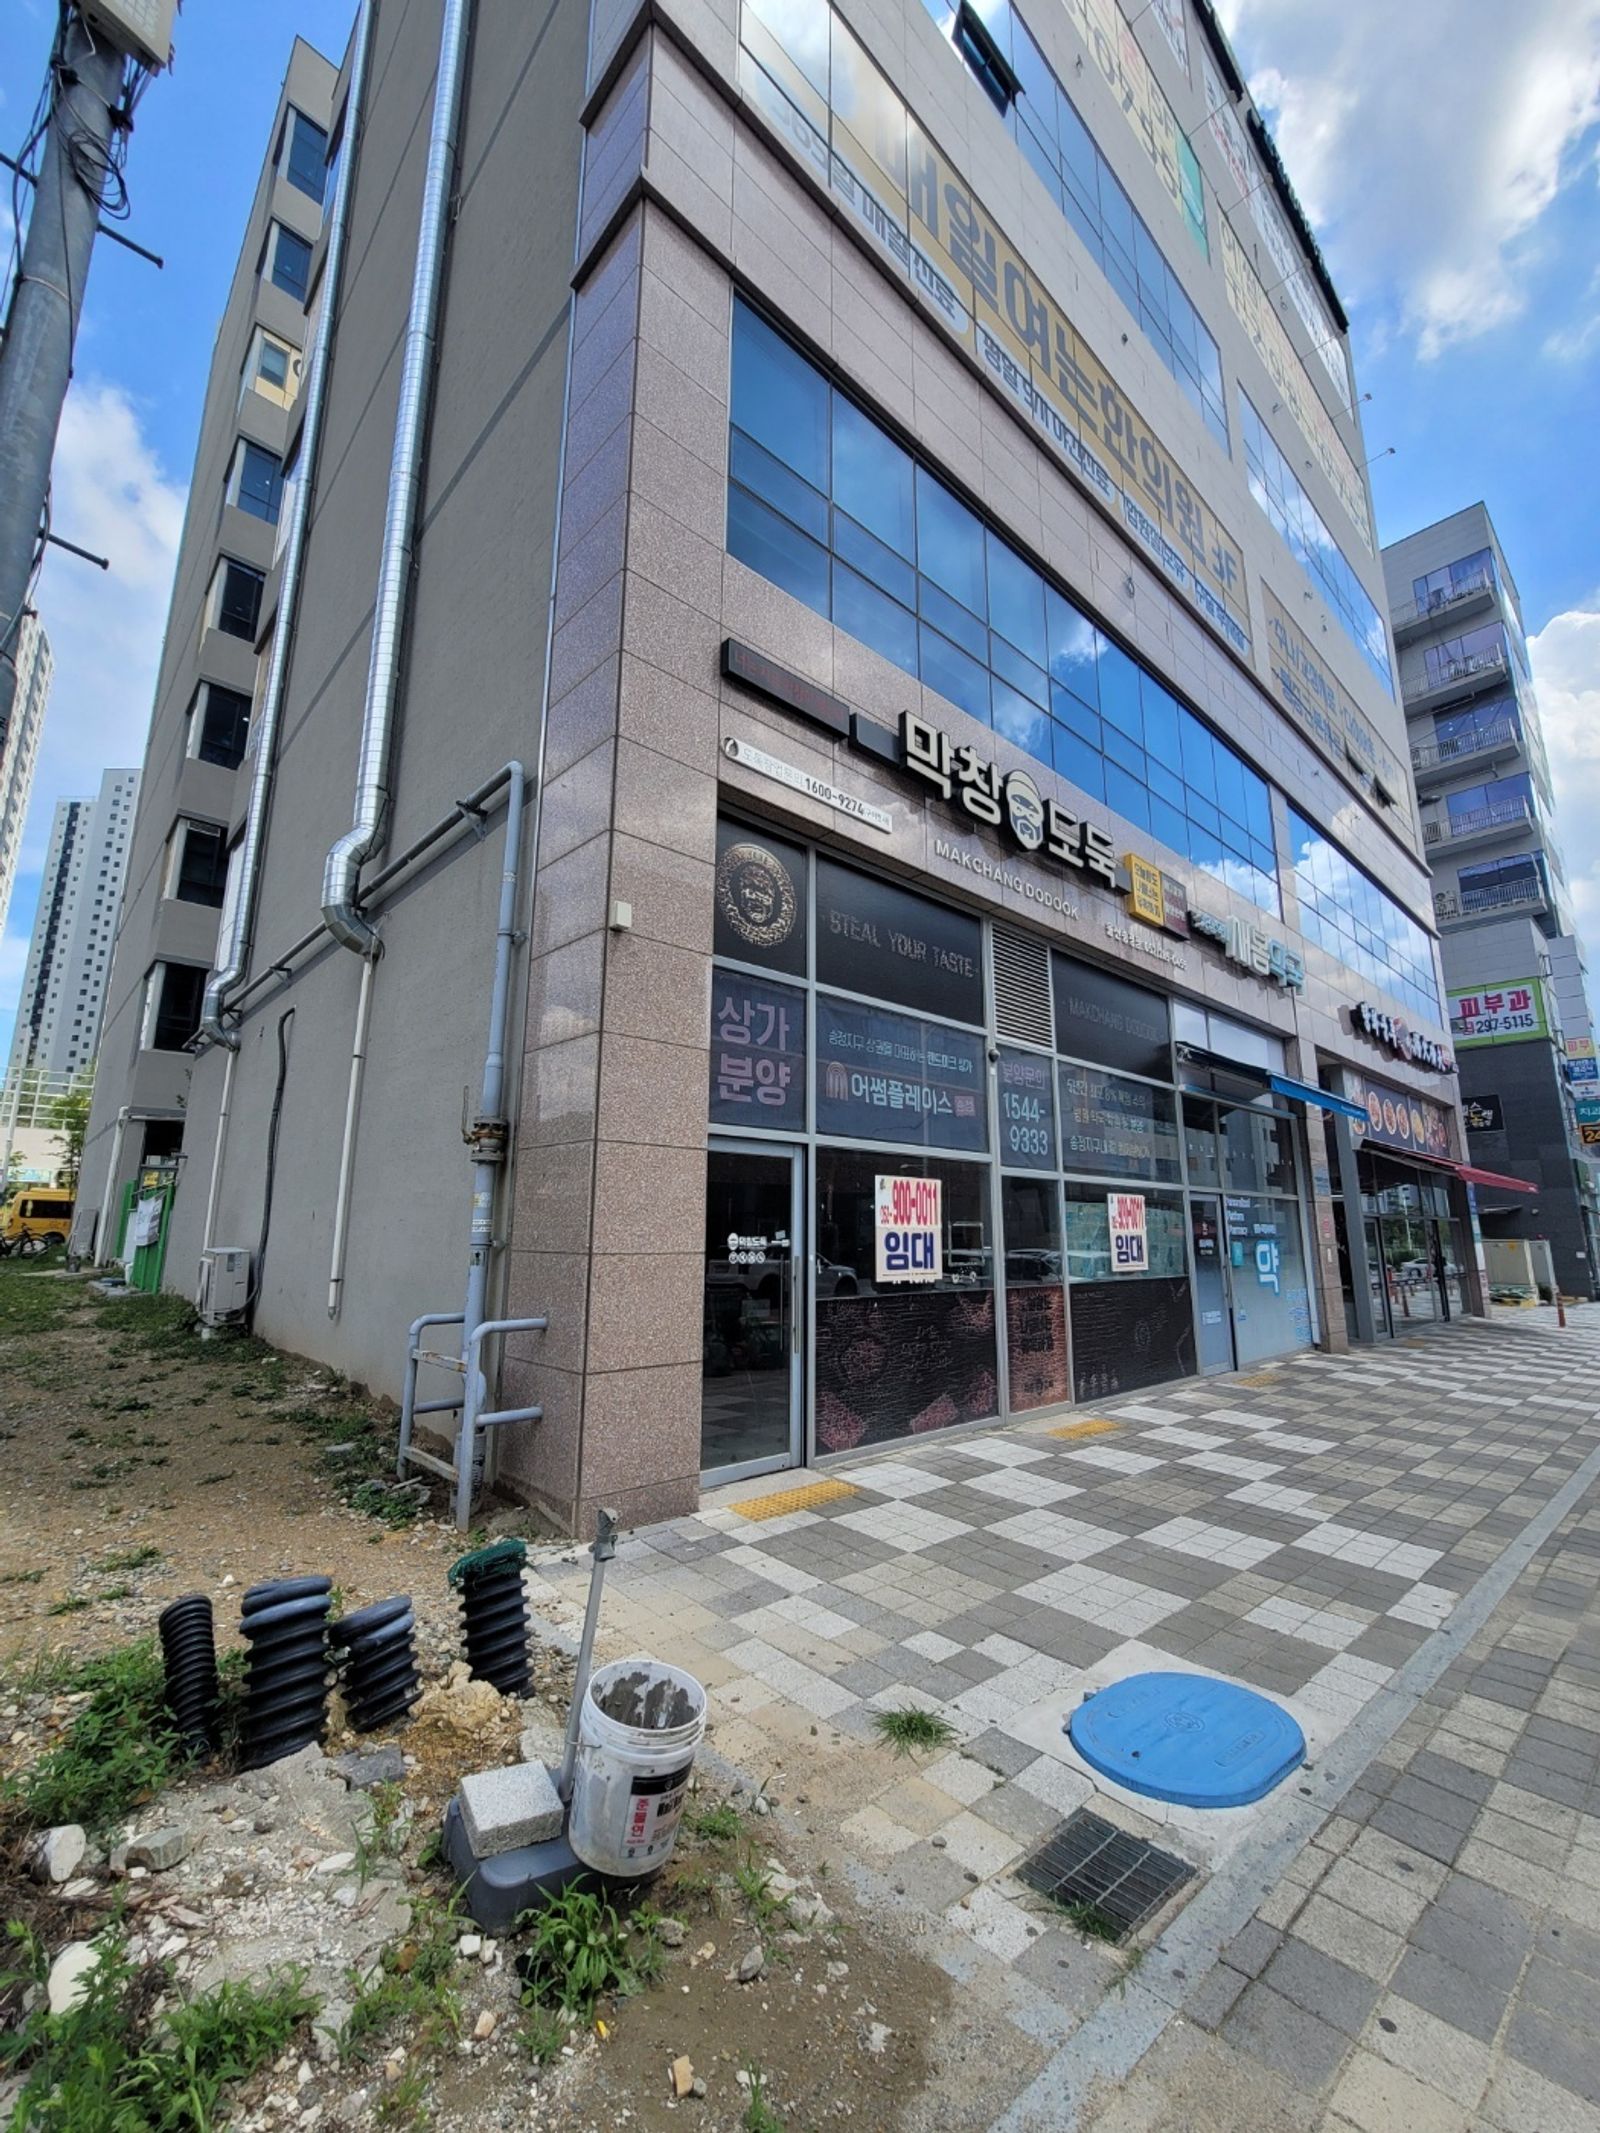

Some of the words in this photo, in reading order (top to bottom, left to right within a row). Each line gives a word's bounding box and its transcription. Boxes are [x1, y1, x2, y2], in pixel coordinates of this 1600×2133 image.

[805, 776, 865, 817] 1600-9274
[907, 710, 1001, 826] 막창
[1049, 798, 1117, 889] 도둑
[935, 838, 1023, 893] MAKCHANG
[1025, 881, 1080, 920] DODOOK
[829, 909, 881, 948] STEAL
[888, 929, 927, 963] YOUR
[932, 945, 975, 978] TASTE
[1230, 915, 1304, 990] 새봄약국
[718, 996, 790, 1051] 상가
[1459, 989, 1530, 1018] 피부과
[1476, 1013, 1534, 1034] 297-5115
[718, 1053, 791, 1106] 분양
[851, 1072, 954, 1115] 어썸플레이스
[1002, 1060, 1046, 1090] 분양문의
[1003, 1092, 1046, 1123] 1544-
[1010, 1125, 1048, 1156] 9333
[884, 1231, 934, 1271] 임대
[1115, 1234, 1144, 1263] 임대
[1255, 1241, 1279, 1294] 약
